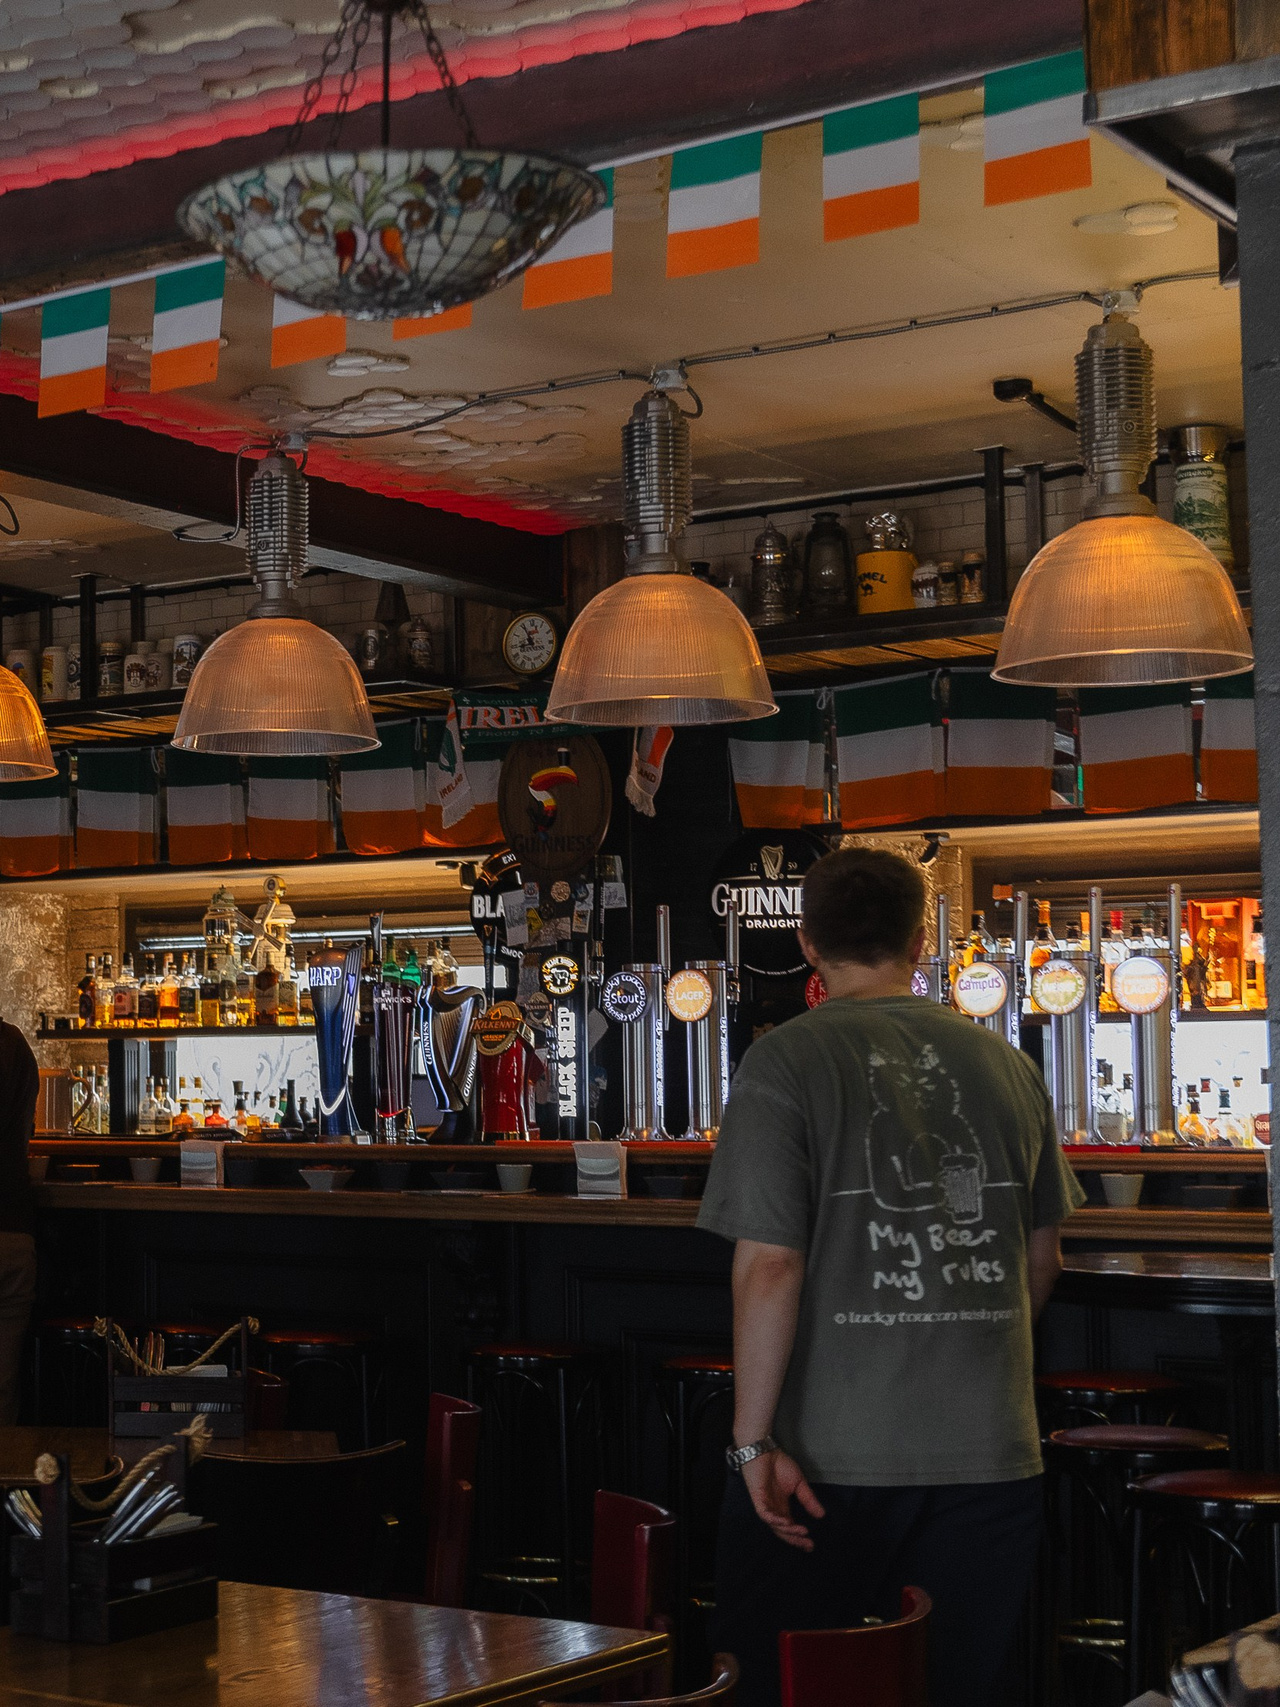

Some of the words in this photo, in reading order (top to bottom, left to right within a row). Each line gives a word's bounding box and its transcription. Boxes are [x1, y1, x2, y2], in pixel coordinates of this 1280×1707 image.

[457, 706, 548, 729] IREL
[529, 728, 544, 736] TO
[439, 773, 464, 799] IRELAND
[472, 894, 506, 919] BLA
[745, 919, 803, 929] DRAUGHT
[309, 966, 342, 988] HARP
[958, 976, 1002, 992] Campus
[610, 992, 640, 1005] Stout
[676, 990, 705, 1001] LAGER
[473, 1020, 518, 1030] KILKENNY
[557, 1007, 576, 1057] SHEEP
[423, 1021, 433, 1066] GUINNESS
[558, 1062, 577, 1118] BLACK
[868, 1221, 922, 1268] My
[927, 1223, 998, 1252] Beer
[941, 1255, 1006, 1285] rules
[848, 1310, 896, 1326] lucky
[898, 1310, 958, 1323] toucan
